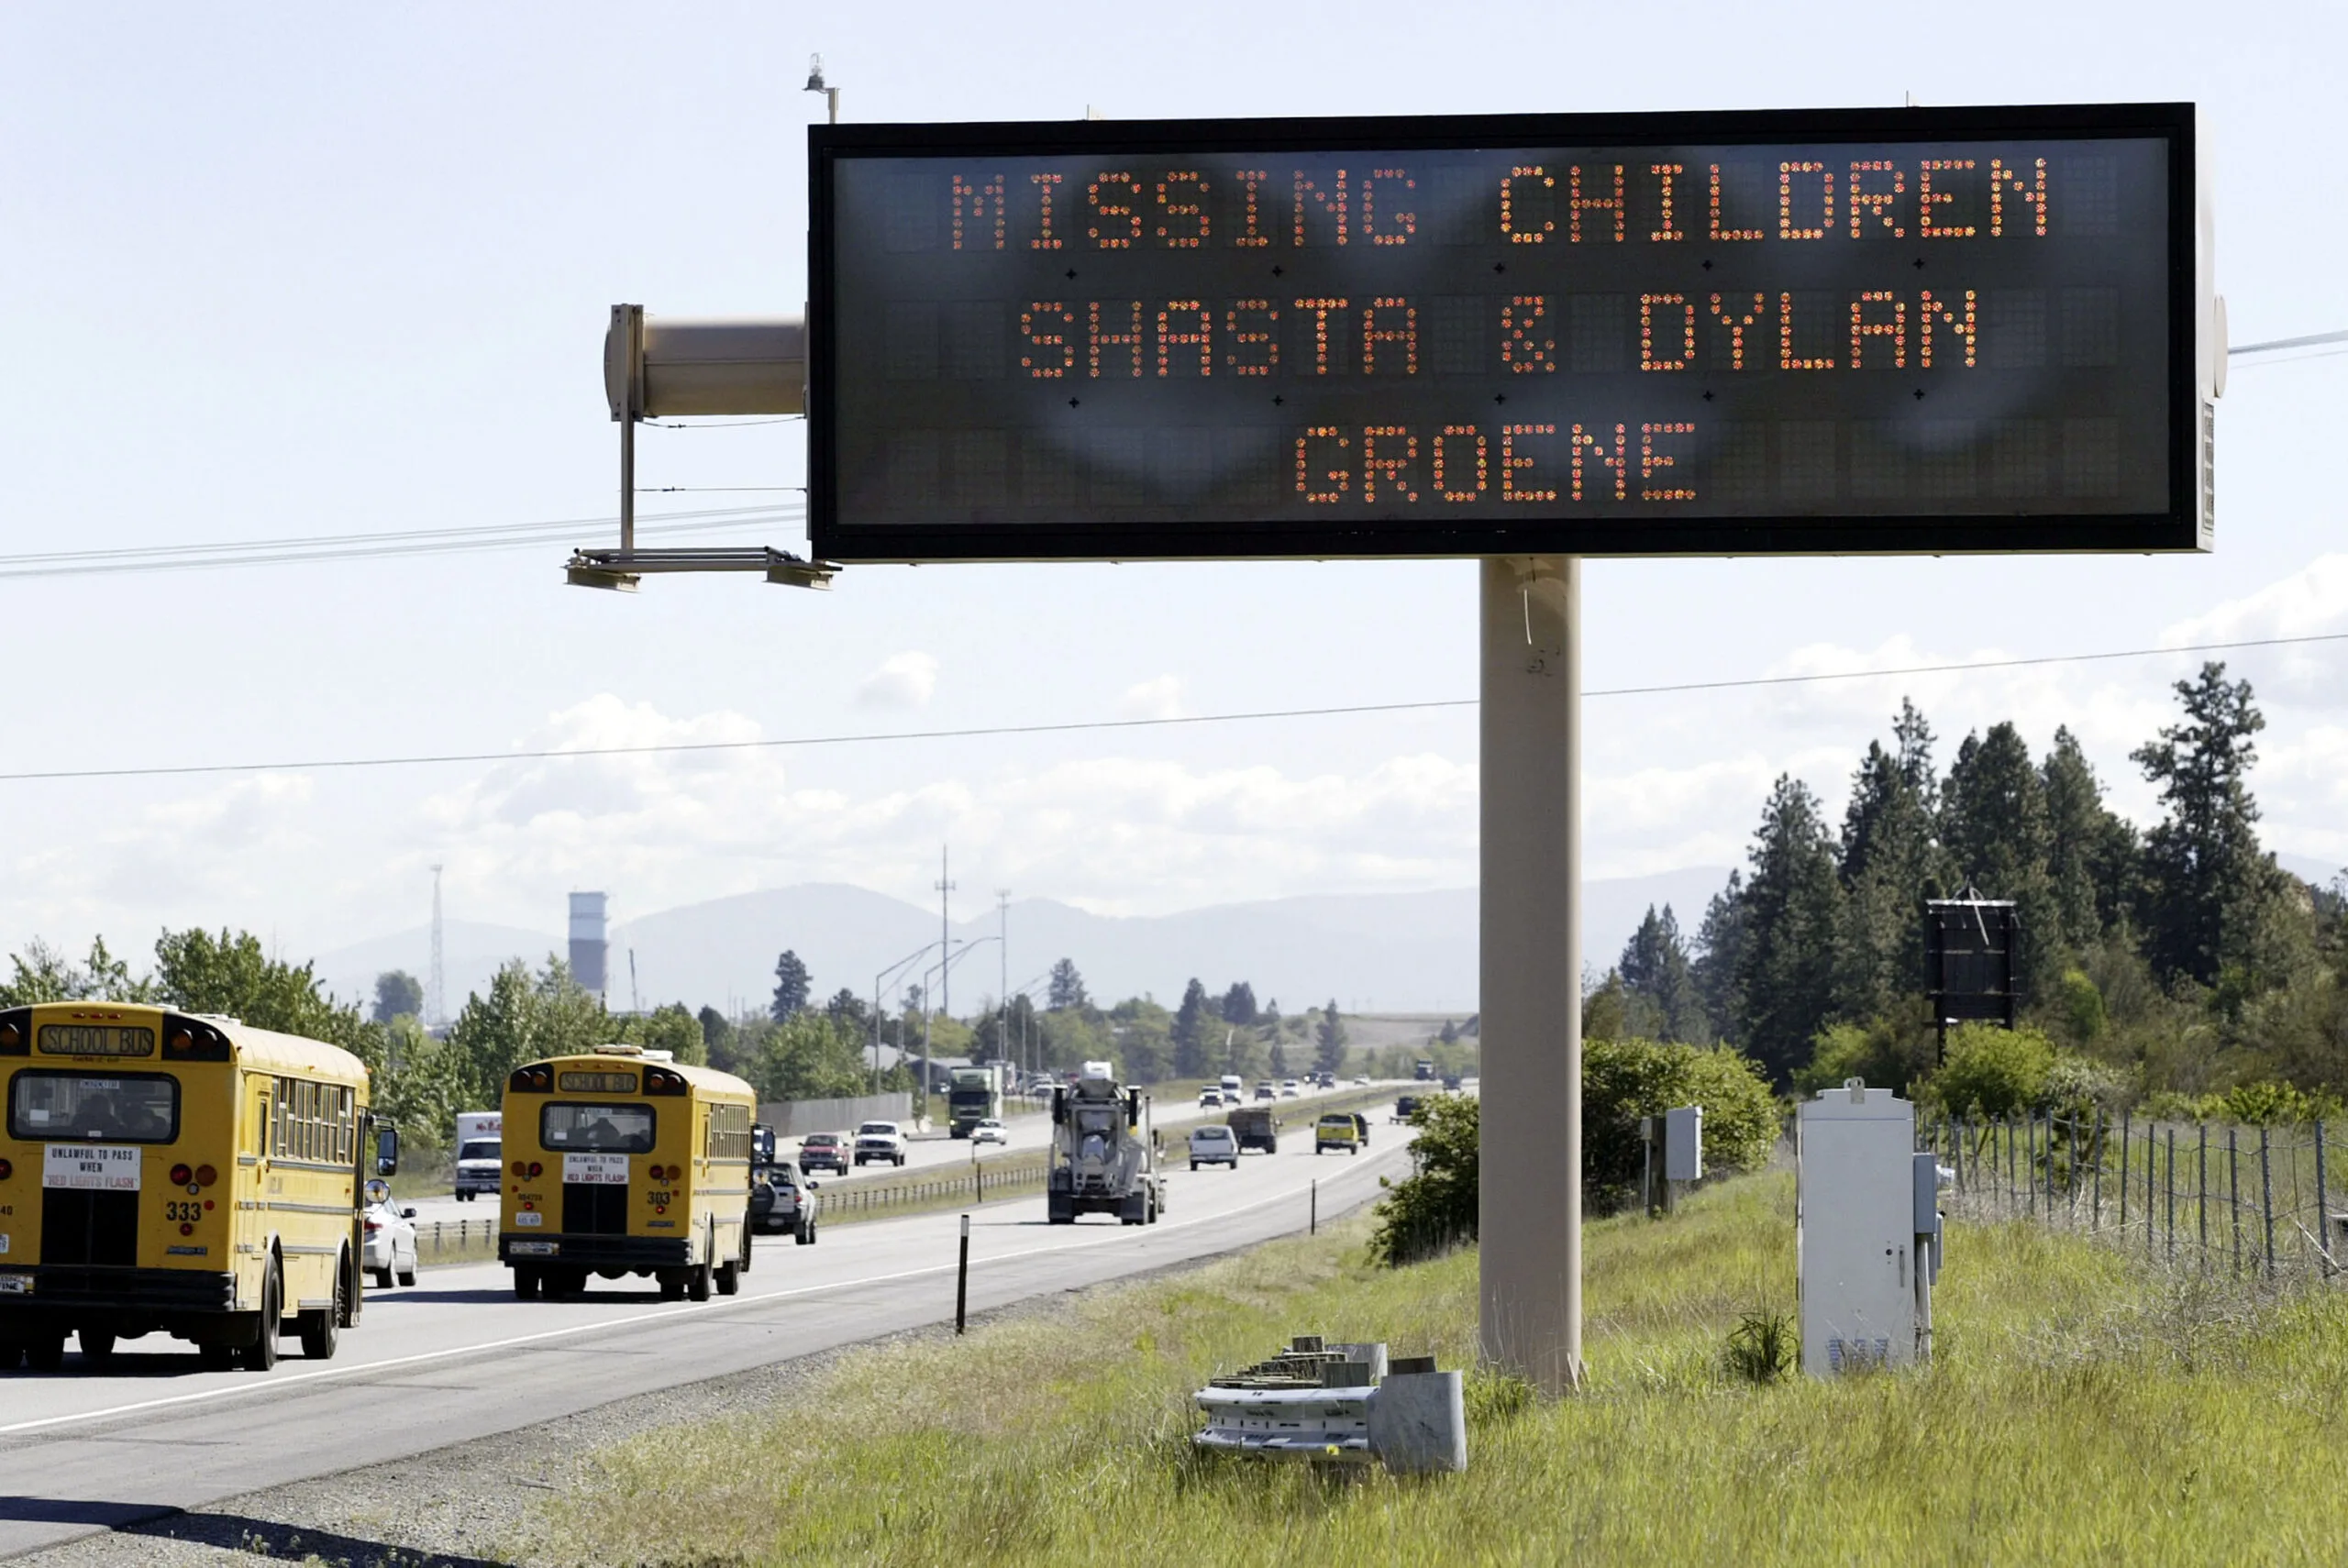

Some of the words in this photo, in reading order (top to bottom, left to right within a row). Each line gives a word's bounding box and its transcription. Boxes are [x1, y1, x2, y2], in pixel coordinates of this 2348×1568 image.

[952, 167, 1417, 251] MISSING
[1500, 157, 2048, 245] CHILDREN
[1020, 296, 1418, 379] SHASTA
[1501, 294, 1556, 375] &
[1640, 289, 1977, 371] DYLAN
[1295, 422, 1696, 504] GROENE
[48, 1026, 116, 1054] SCHOOL
[119, 1027, 153, 1055] BUS
[51, 1148, 94, 1159] UNLAWFUL
[98, 1149, 108, 1159] TO
[112, 1150, 133, 1160] PASS
[80, 1162, 103, 1173] WHEN
[70, 1176, 102, 1187] LIGHTS
[647, 1191, 670, 1205] 303
[166, 1201, 202, 1221] 333
